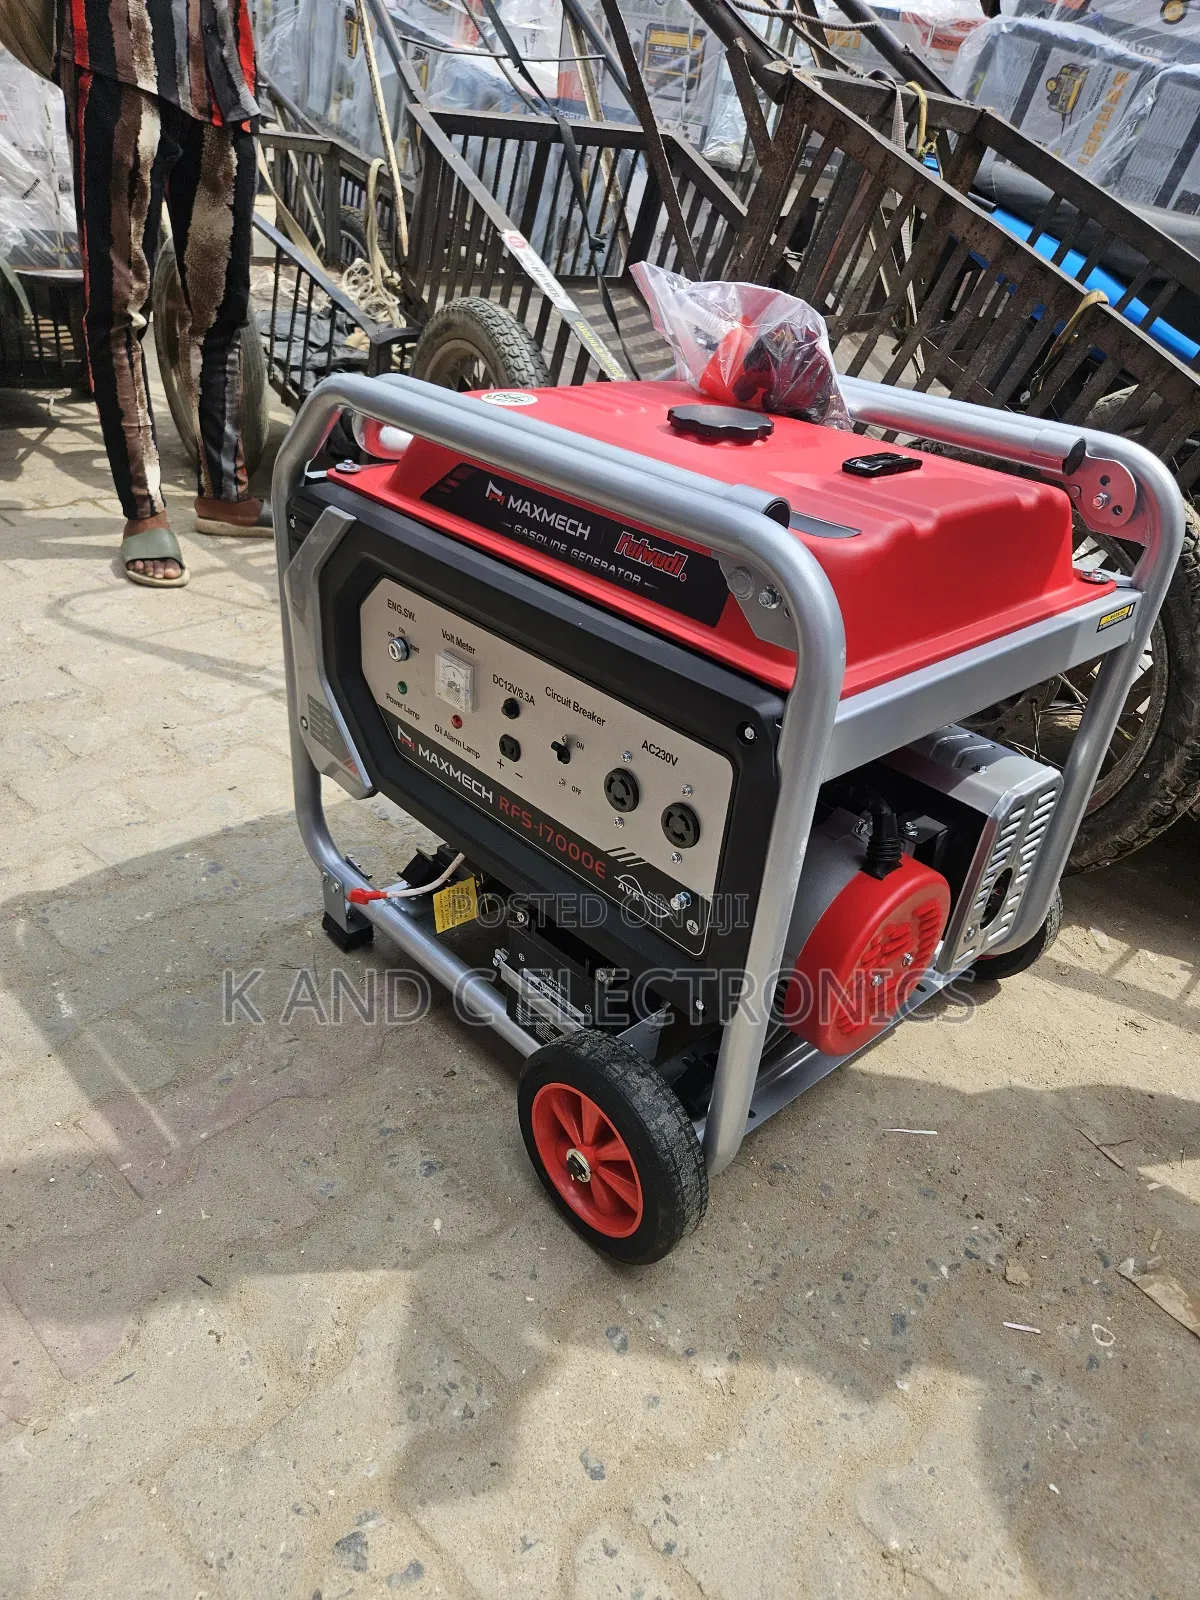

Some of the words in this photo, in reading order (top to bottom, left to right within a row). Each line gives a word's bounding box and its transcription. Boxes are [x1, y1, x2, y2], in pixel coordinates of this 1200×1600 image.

[507, 494, 591, 541] MAXMECH
[513, 524, 568, 554] GASOLINE
[570, 548, 642, 585] GENERATOR
[387, 598, 417, 623] ENG.SW.
[441, 628, 455, 645] Volt
[455, 636, 476, 655] Meter
[386, 692, 403, 709] Power
[403, 703, 421, 721] Lamp
[492, 673, 536, 707] DC12V/8.3A
[545, 686, 572, 709] Circuit
[572, 700, 607, 727] Breaker
[434, 723, 443, 735] Oil
[443, 730, 462, 746] Alarm
[462, 741, 481, 760] Lamp
[641, 739, 679, 766] AC230V
[418, 743, 493, 804] MAXMECH
[499, 795, 607, 880] RFS-17000E
[617, 881, 642, 902] AVR
